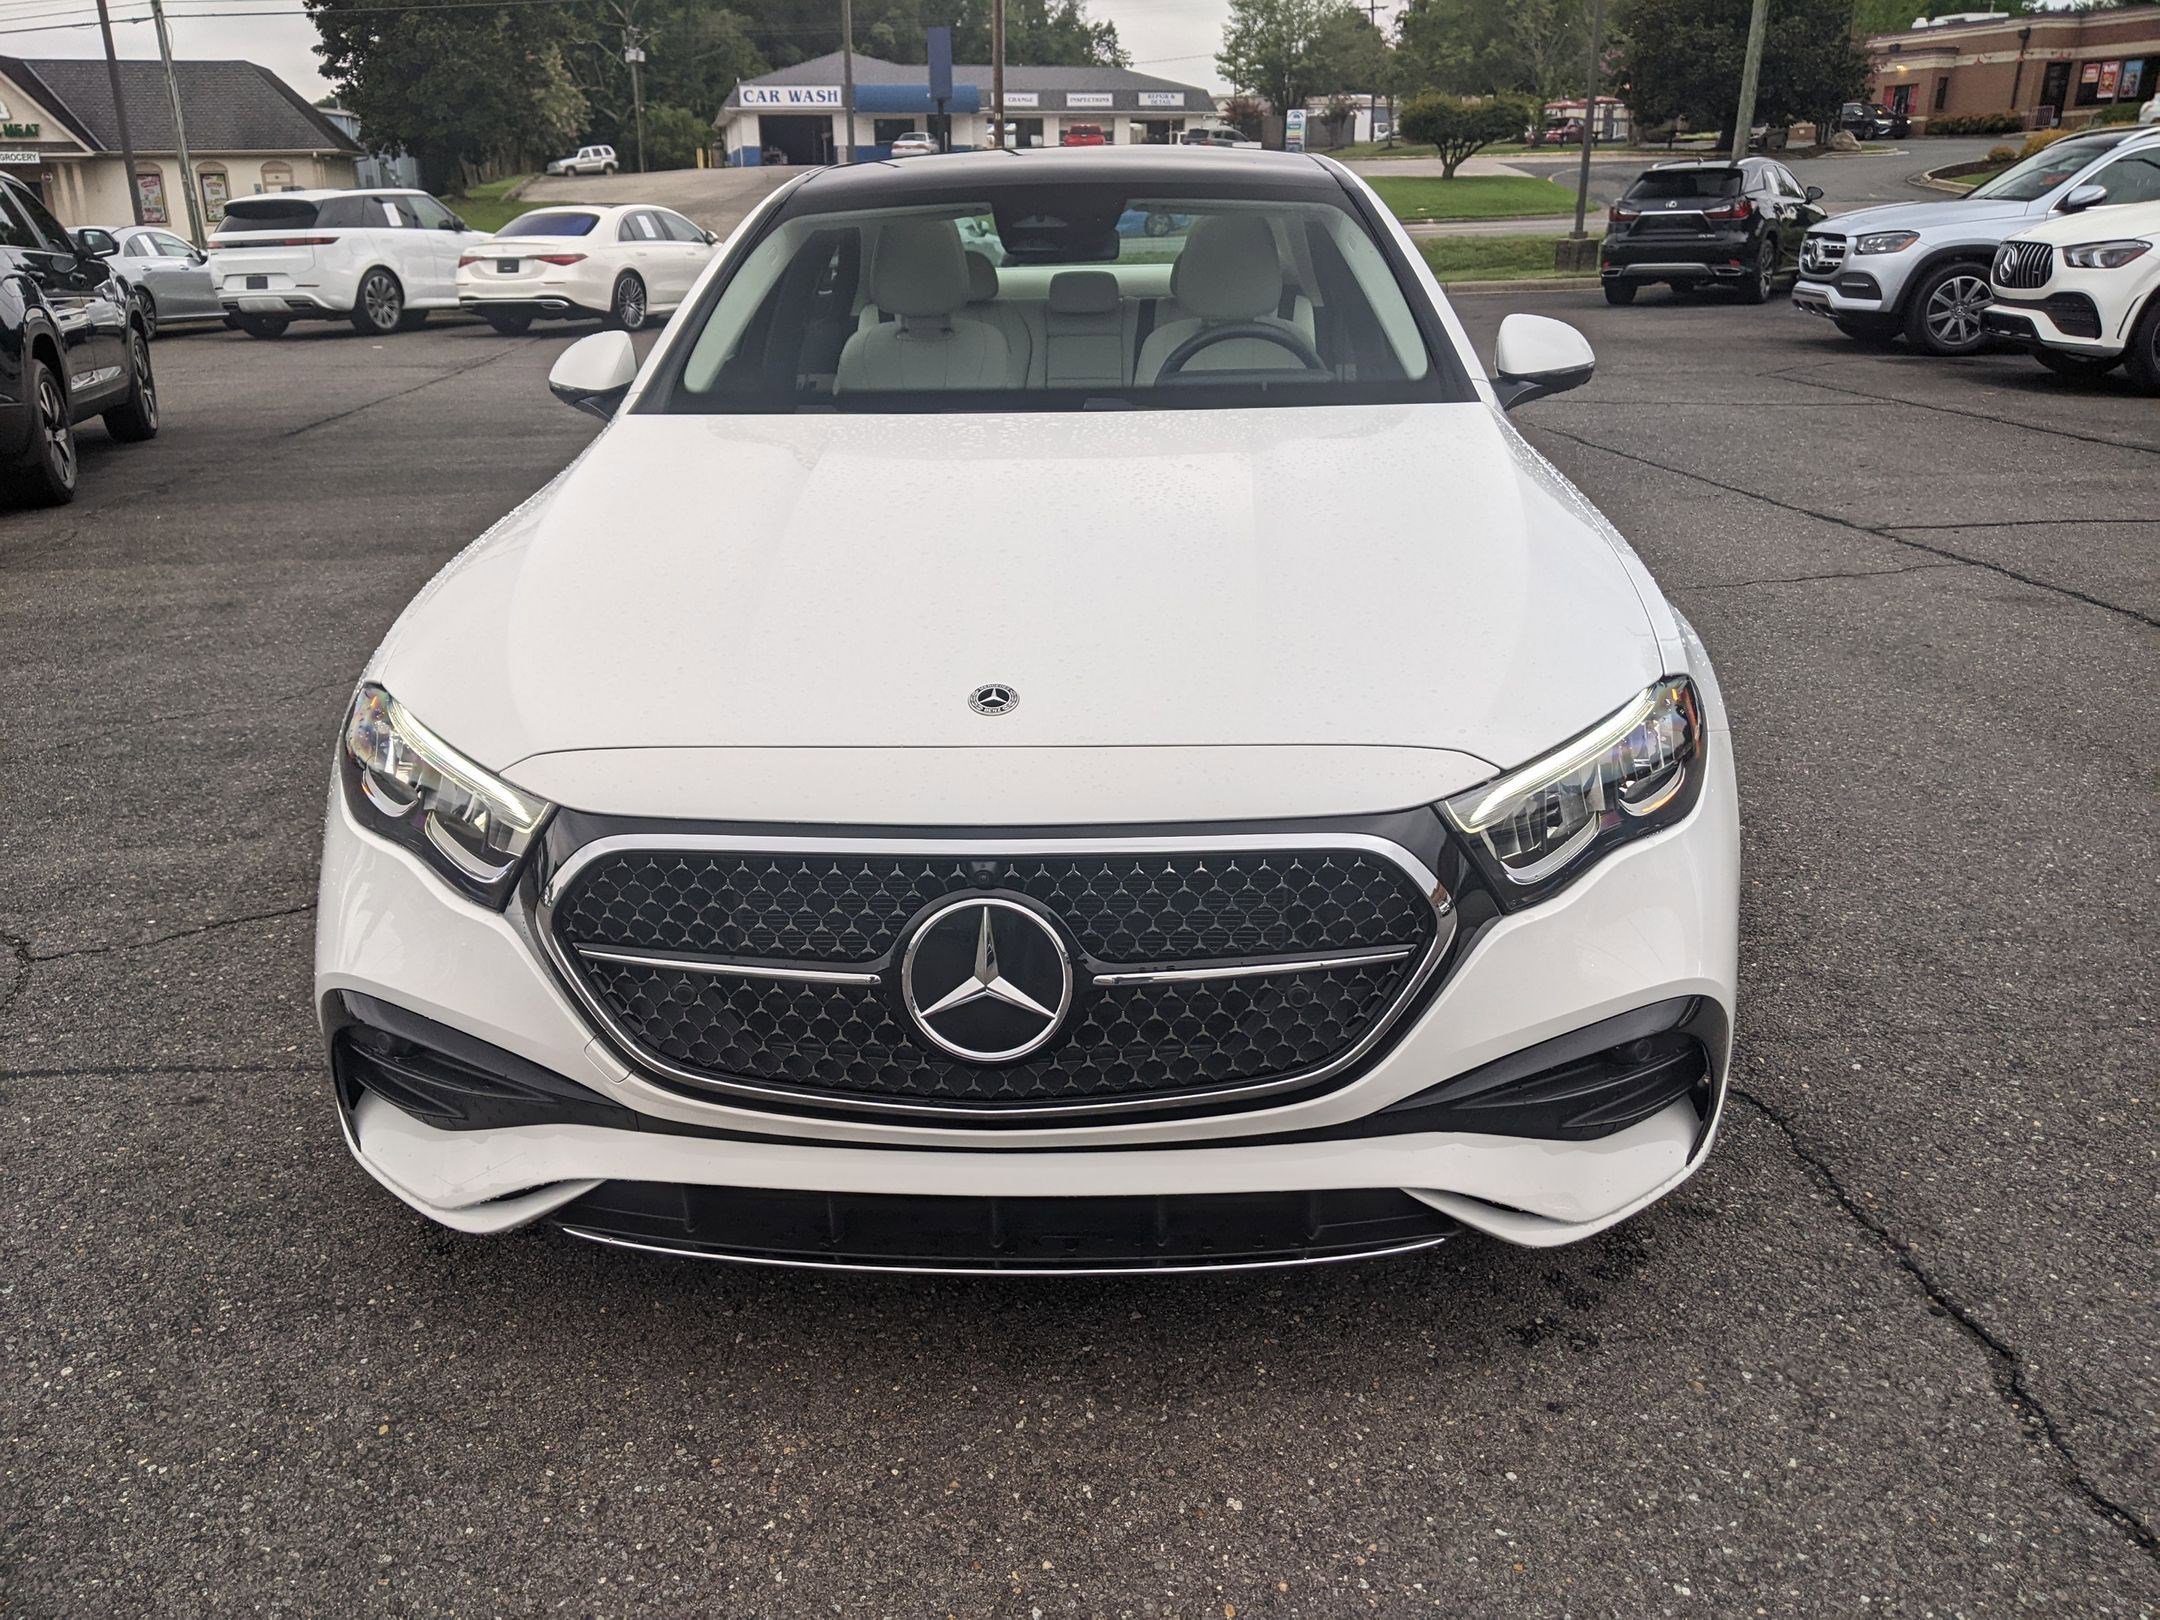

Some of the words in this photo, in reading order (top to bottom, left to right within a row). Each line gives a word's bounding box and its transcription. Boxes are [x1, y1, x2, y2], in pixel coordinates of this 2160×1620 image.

[743, 89, 780, 103] CAR
[788, 89, 838, 103] WASH
[0, 153, 36, 161] GROCERY
